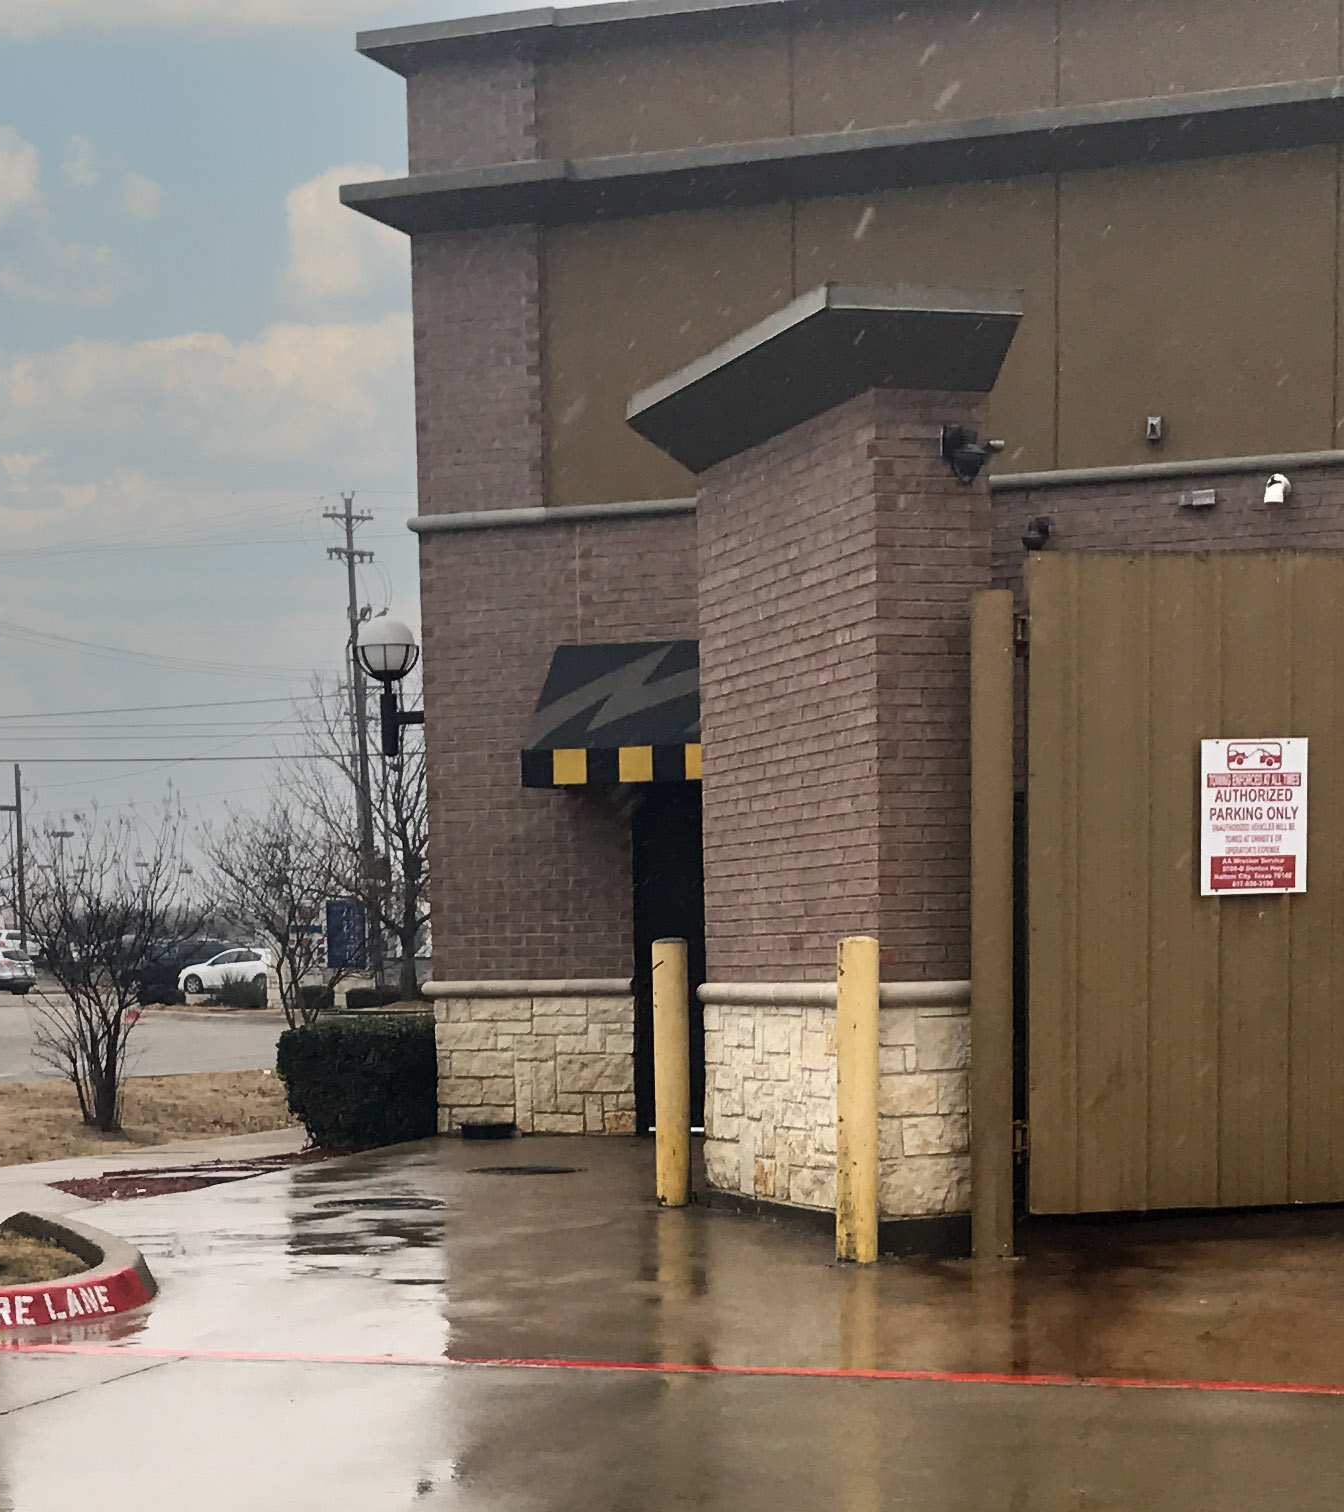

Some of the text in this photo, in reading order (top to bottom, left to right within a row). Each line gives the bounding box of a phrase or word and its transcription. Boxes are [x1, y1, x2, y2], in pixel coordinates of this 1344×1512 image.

[1214, 788, 1293, 803] AUTHORIZED
[1209, 806, 1299, 821] PARKING ONLY
[42, 1285, 116, 1321] LANE
